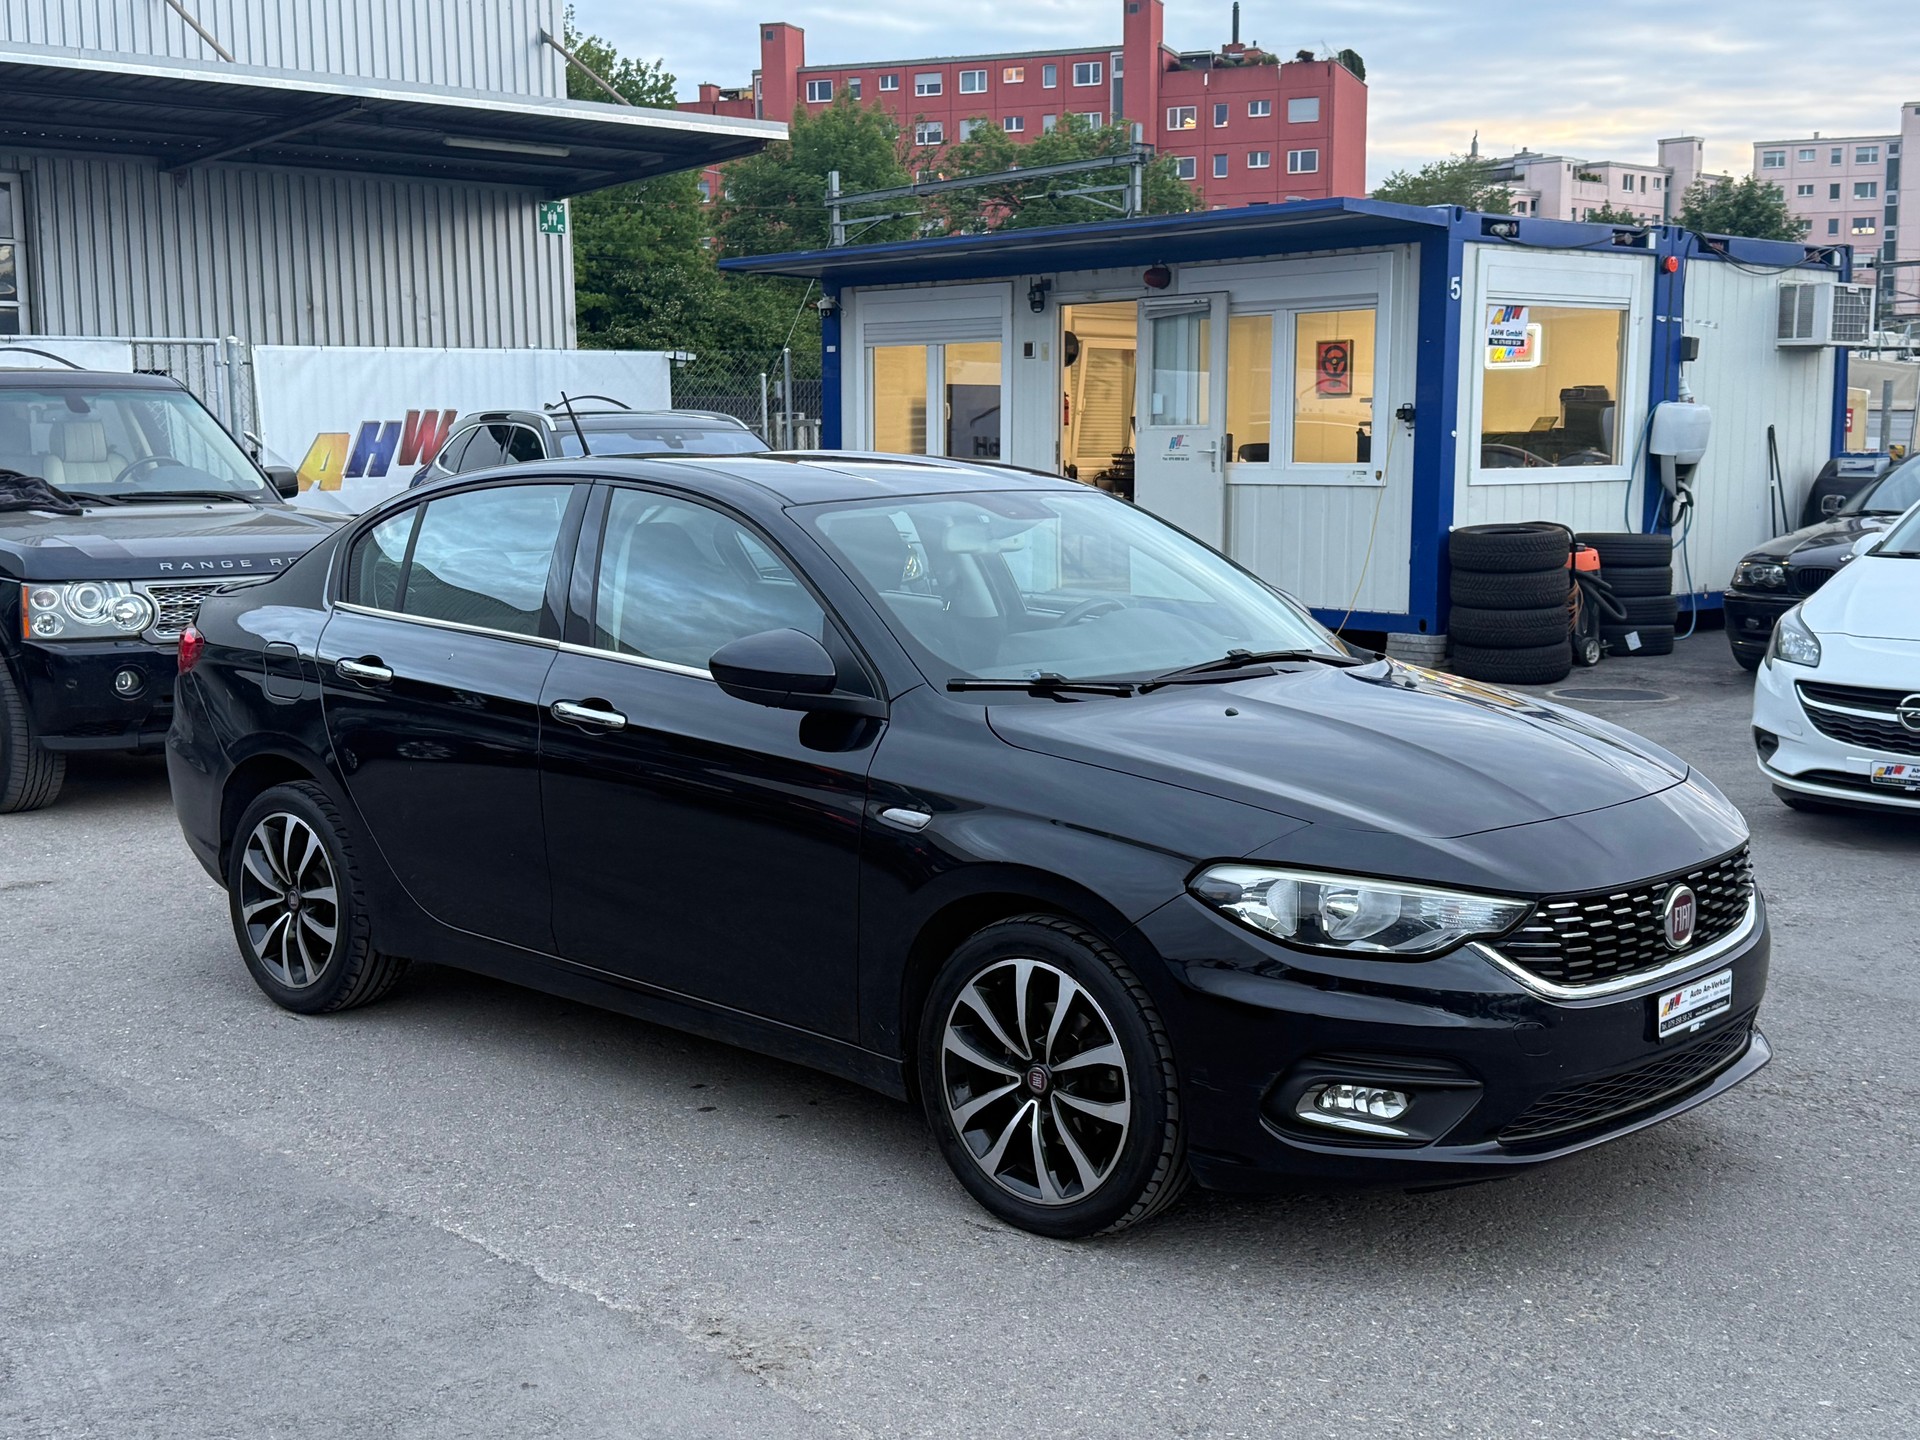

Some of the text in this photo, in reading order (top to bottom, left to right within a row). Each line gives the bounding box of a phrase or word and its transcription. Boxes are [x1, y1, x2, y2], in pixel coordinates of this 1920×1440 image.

[1450, 276, 1461, 300] 5
[1491, 305, 1523, 325] AHW
[1505, 329, 1523, 337] GmbH
[297, 409, 458, 492] AHW
[159, 559, 253, 571] RANGE
[1873, 765, 1906, 777] AHW
[1674, 903, 1691, 933] FIAT
[1689, 988, 1703, 999] Auto
[1702, 975, 1731, 992] An-Verkauf
[1661, 992, 1683, 1017] AHW
